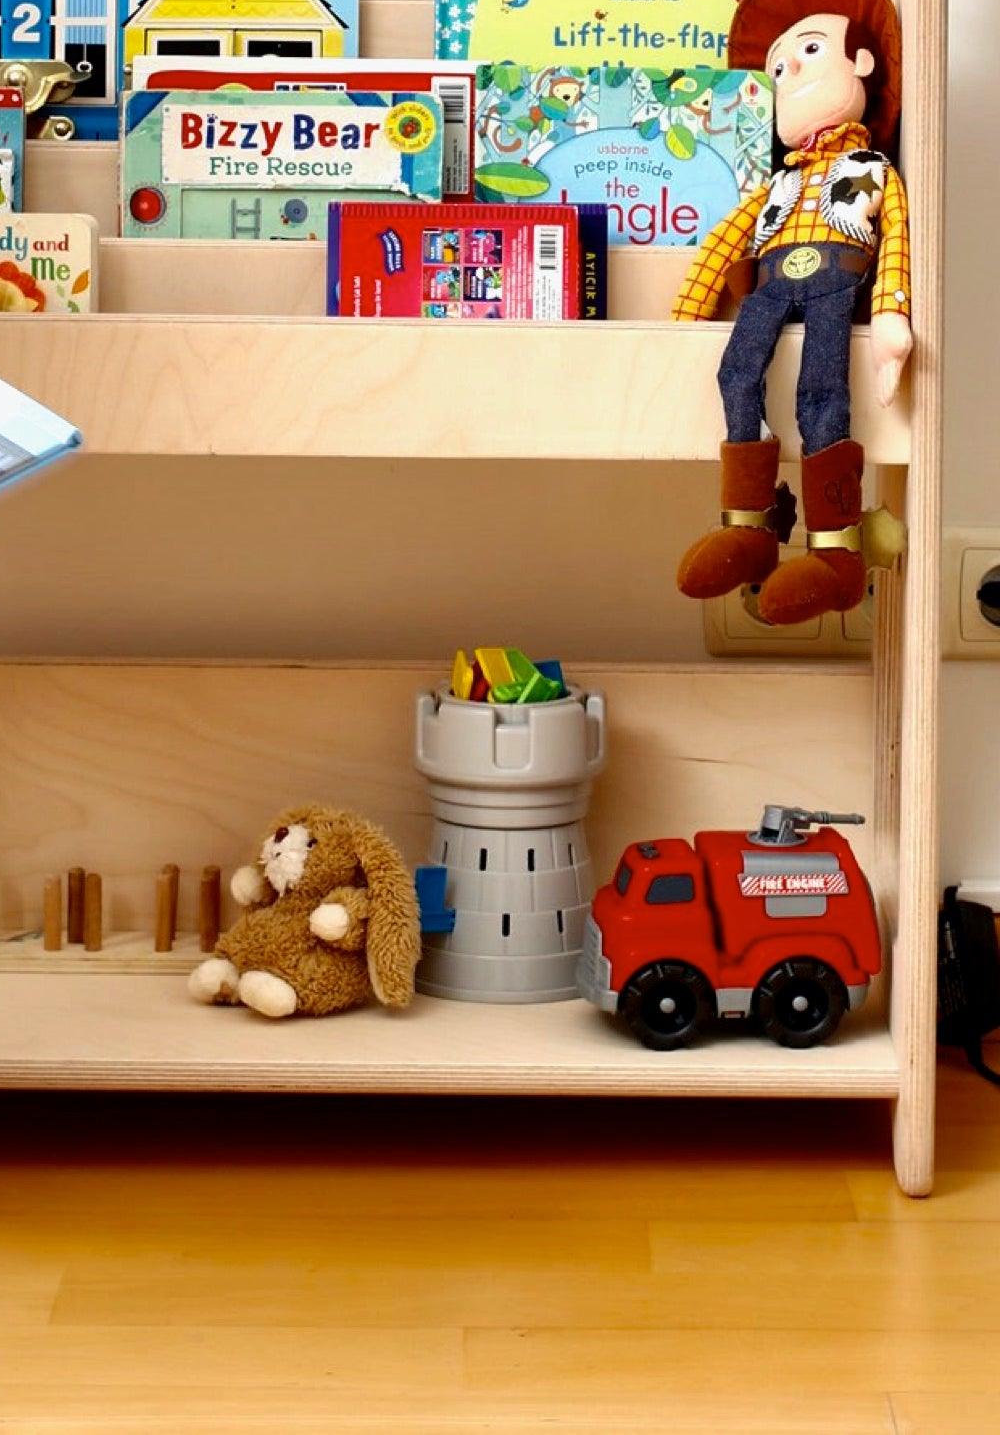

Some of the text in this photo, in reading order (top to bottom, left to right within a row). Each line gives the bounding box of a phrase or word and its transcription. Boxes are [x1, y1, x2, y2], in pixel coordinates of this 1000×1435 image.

[12, 3, 41, 44] 2
[181, 112, 283, 156] Bizzy
[293, 113, 381, 150] Bear
[209, 156, 353, 176] Fire Rescue
[574, 157, 673, 180] peep inside
[605, 177, 640, 198] the
[32, 234, 70, 252] and
[30, 256, 70, 281] Me
